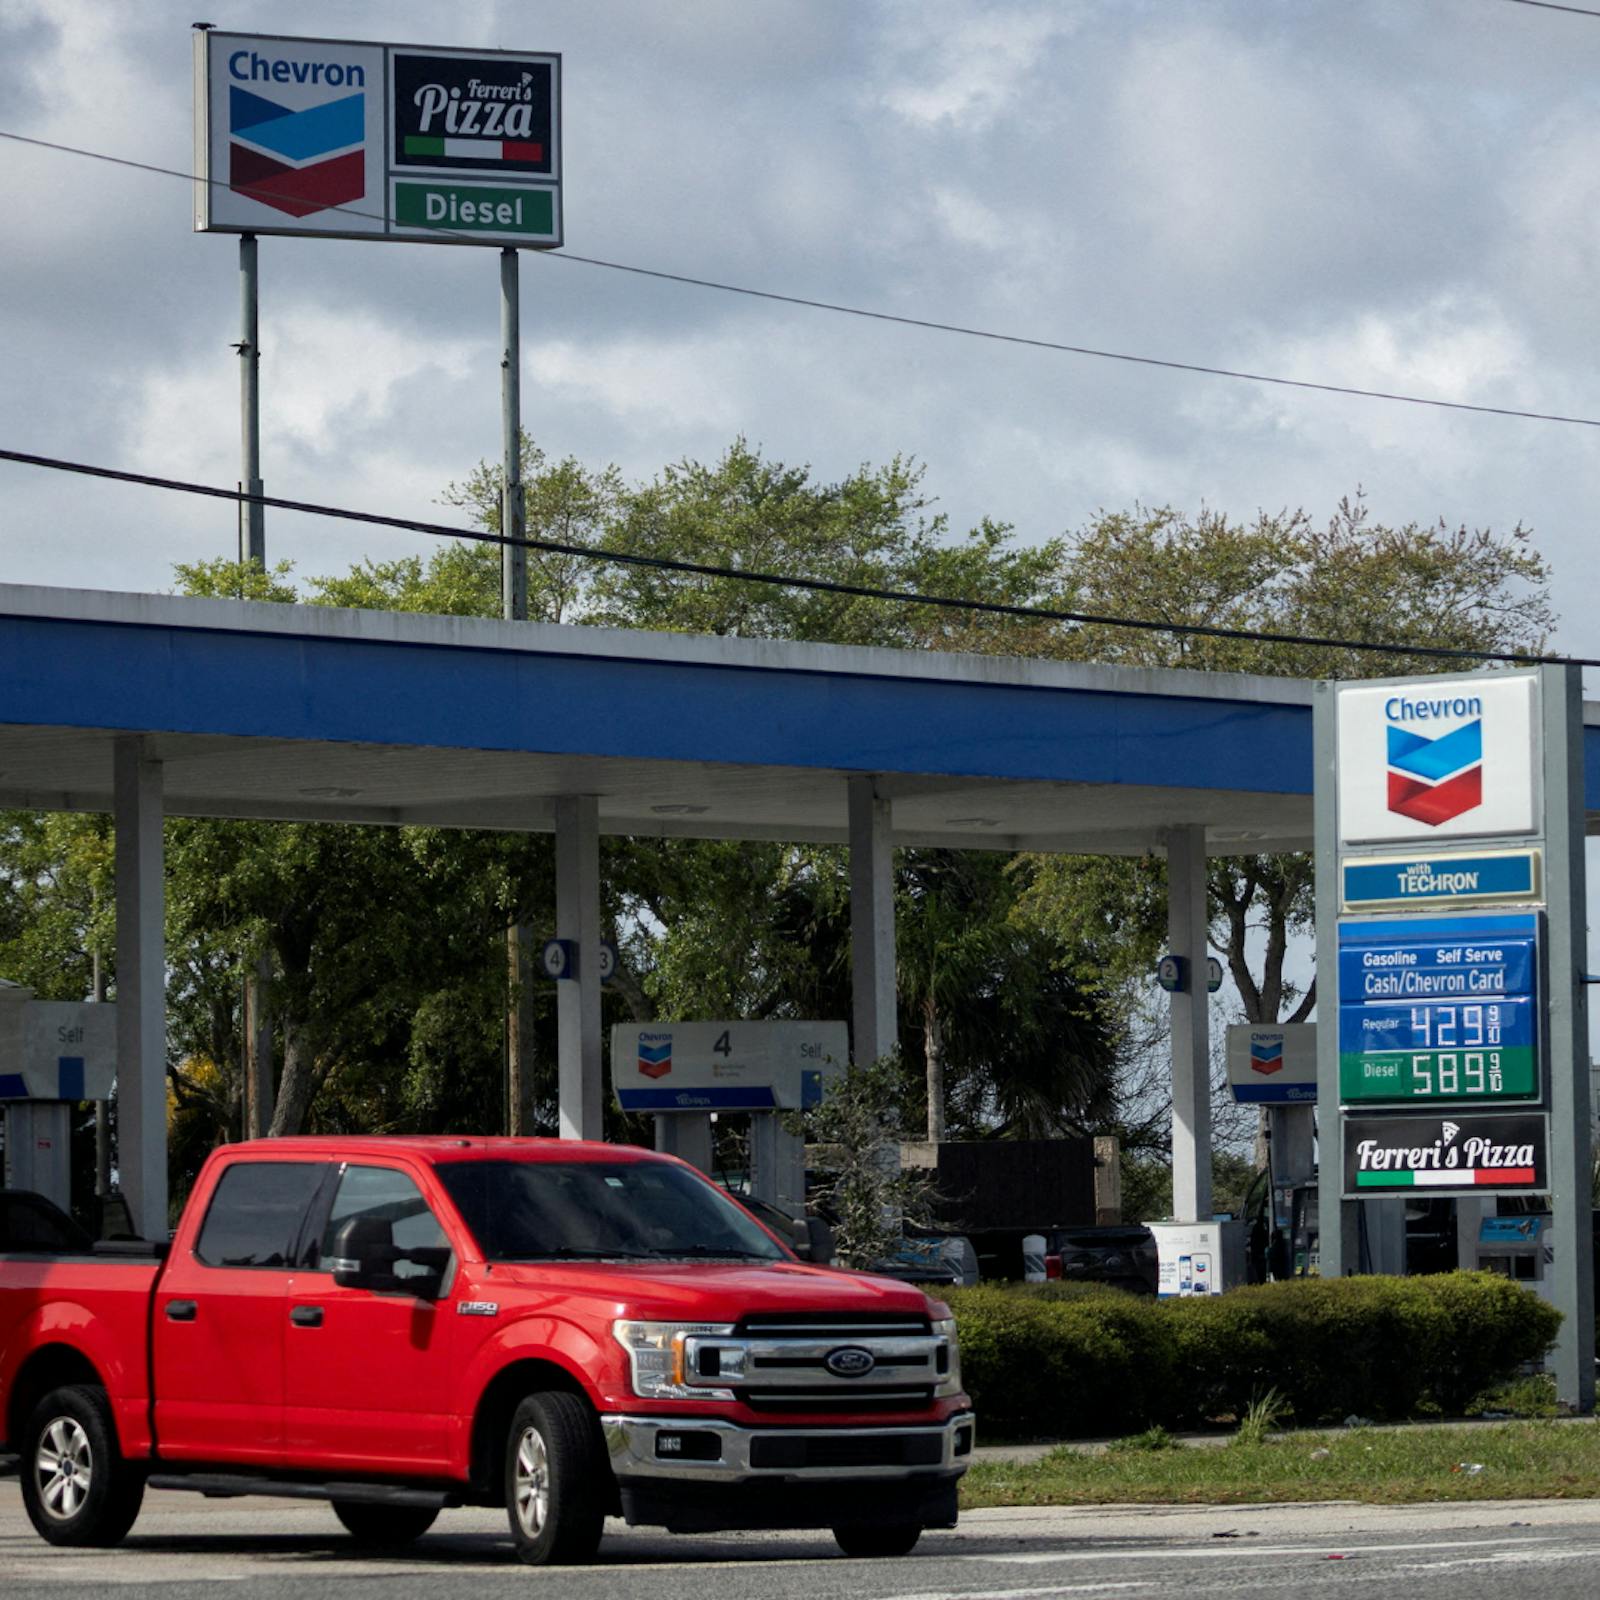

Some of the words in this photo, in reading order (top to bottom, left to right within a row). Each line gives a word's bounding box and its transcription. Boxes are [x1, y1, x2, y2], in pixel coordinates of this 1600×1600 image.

[229, 50, 365, 87] Chevron
[413, 83, 533, 138] Pizza
[426, 193, 523, 225] Diesel
[1385, 697, 1481, 720] Chevron
[1406, 863, 1431, 875] with
[1397, 872, 1479, 894] TECHRON
[550, 950, 560, 968] 4
[600, 952, 608, 970] 3
[1363, 951, 1417, 967] Gasoline
[1436, 949, 1461, 963] Self
[1465, 948, 1503, 962] Serve
[1165, 964, 1172, 978] 2
[1365, 970, 1465, 994] Cash/Chevron
[1469, 968, 1504, 990] Card
[58, 1026, 84, 1043] Self
[638, 1032, 673, 1041] Chevron
[1251, 1032, 1283, 1041] Chevron
[1362, 1018, 1399, 1031] Regular
[1411, 1005, 1483, 1046] 429
[713, 1030, 732, 1057] 4
[801, 1043, 822, 1058] Self
[1364, 1063, 1398, 1077] Diesel
[1413, 1053, 1485, 1094] 589
[1463, 1136, 1535, 1168] Pizza
